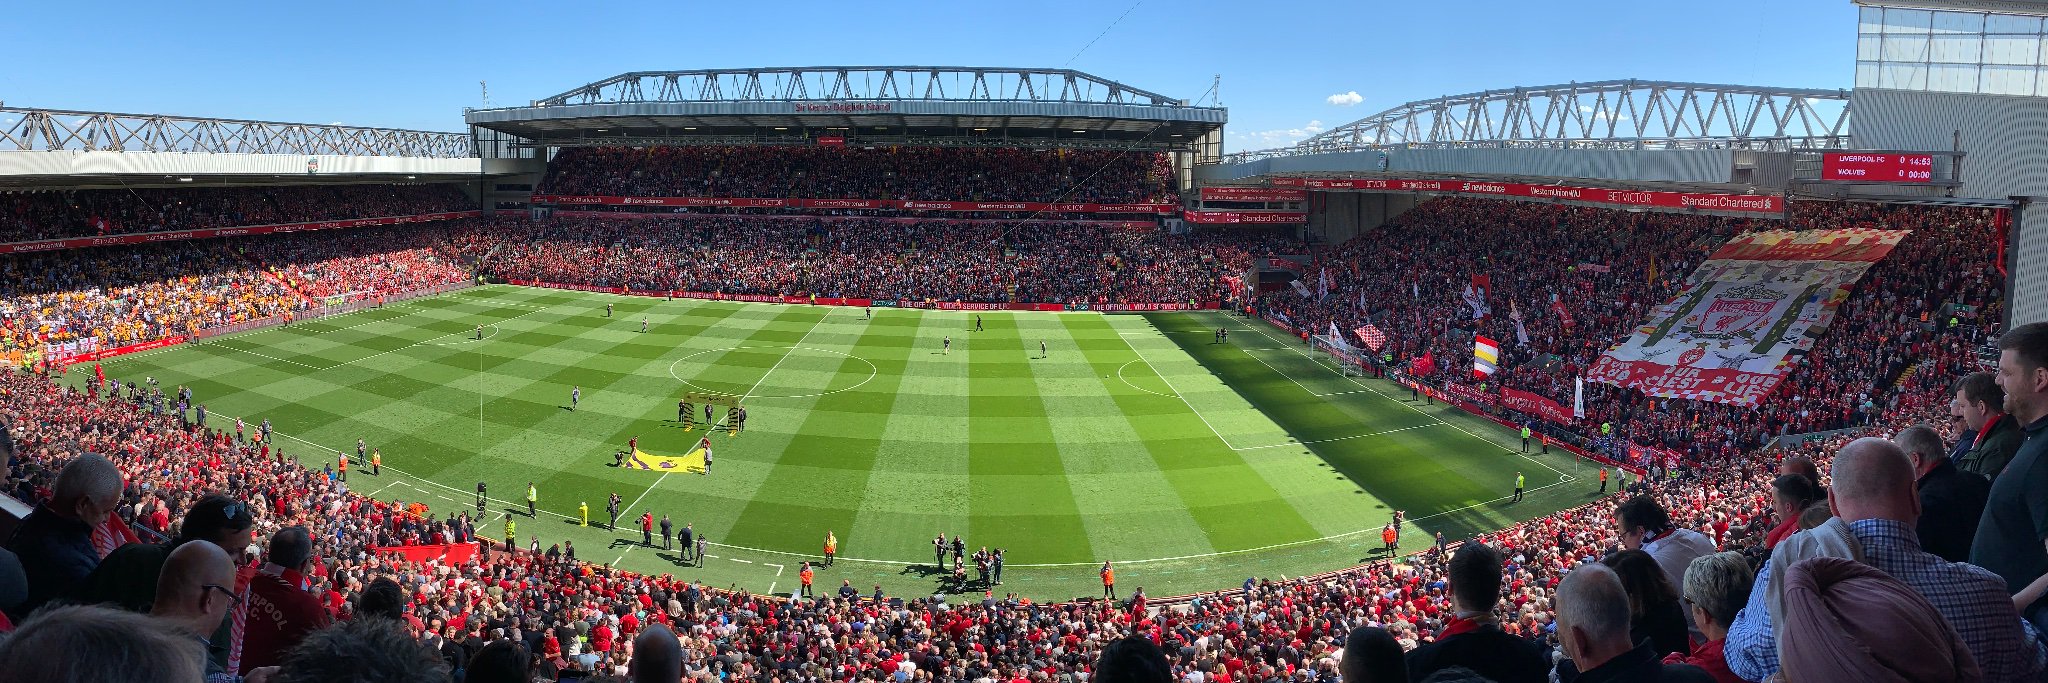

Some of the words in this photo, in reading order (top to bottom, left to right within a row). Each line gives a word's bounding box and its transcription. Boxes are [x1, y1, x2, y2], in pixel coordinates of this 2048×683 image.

[833, 103, 864, 113] Dalglish
[867, 103, 891, 112] Stand
[1900, 156, 1905, 164] 0
[1838, 168, 1865, 176] WOLVES
[1899, 169, 1904, 177] 0
[1908, 170, 1930, 179] 00:00
[1681, 195, 1718, 206] Standard
[1719, 196, 1764, 209] Chartered
[900, 300, 912, 308] THE
[962, 302, 986, 310] SERVICE
